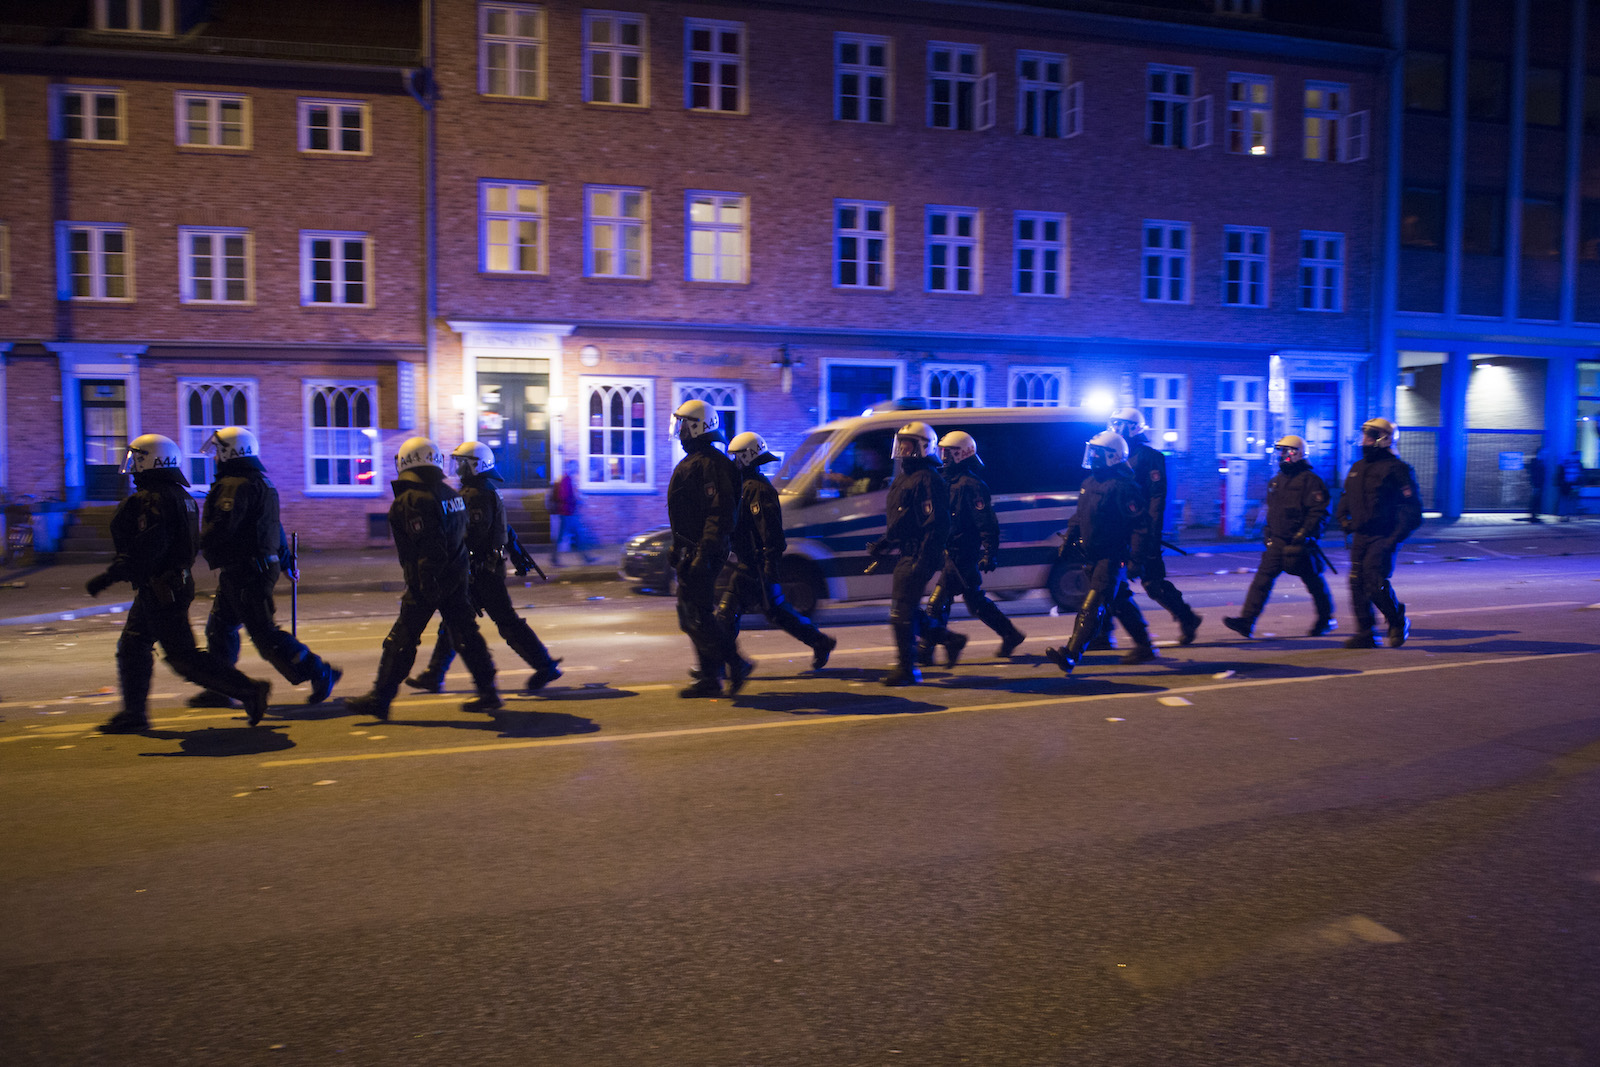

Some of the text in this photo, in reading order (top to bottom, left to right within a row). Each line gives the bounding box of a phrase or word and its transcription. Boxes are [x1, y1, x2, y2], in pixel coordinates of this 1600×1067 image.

[230, 445, 252, 457] A44
[154, 455, 177, 468] A44
[401, 451, 421, 467] A44
